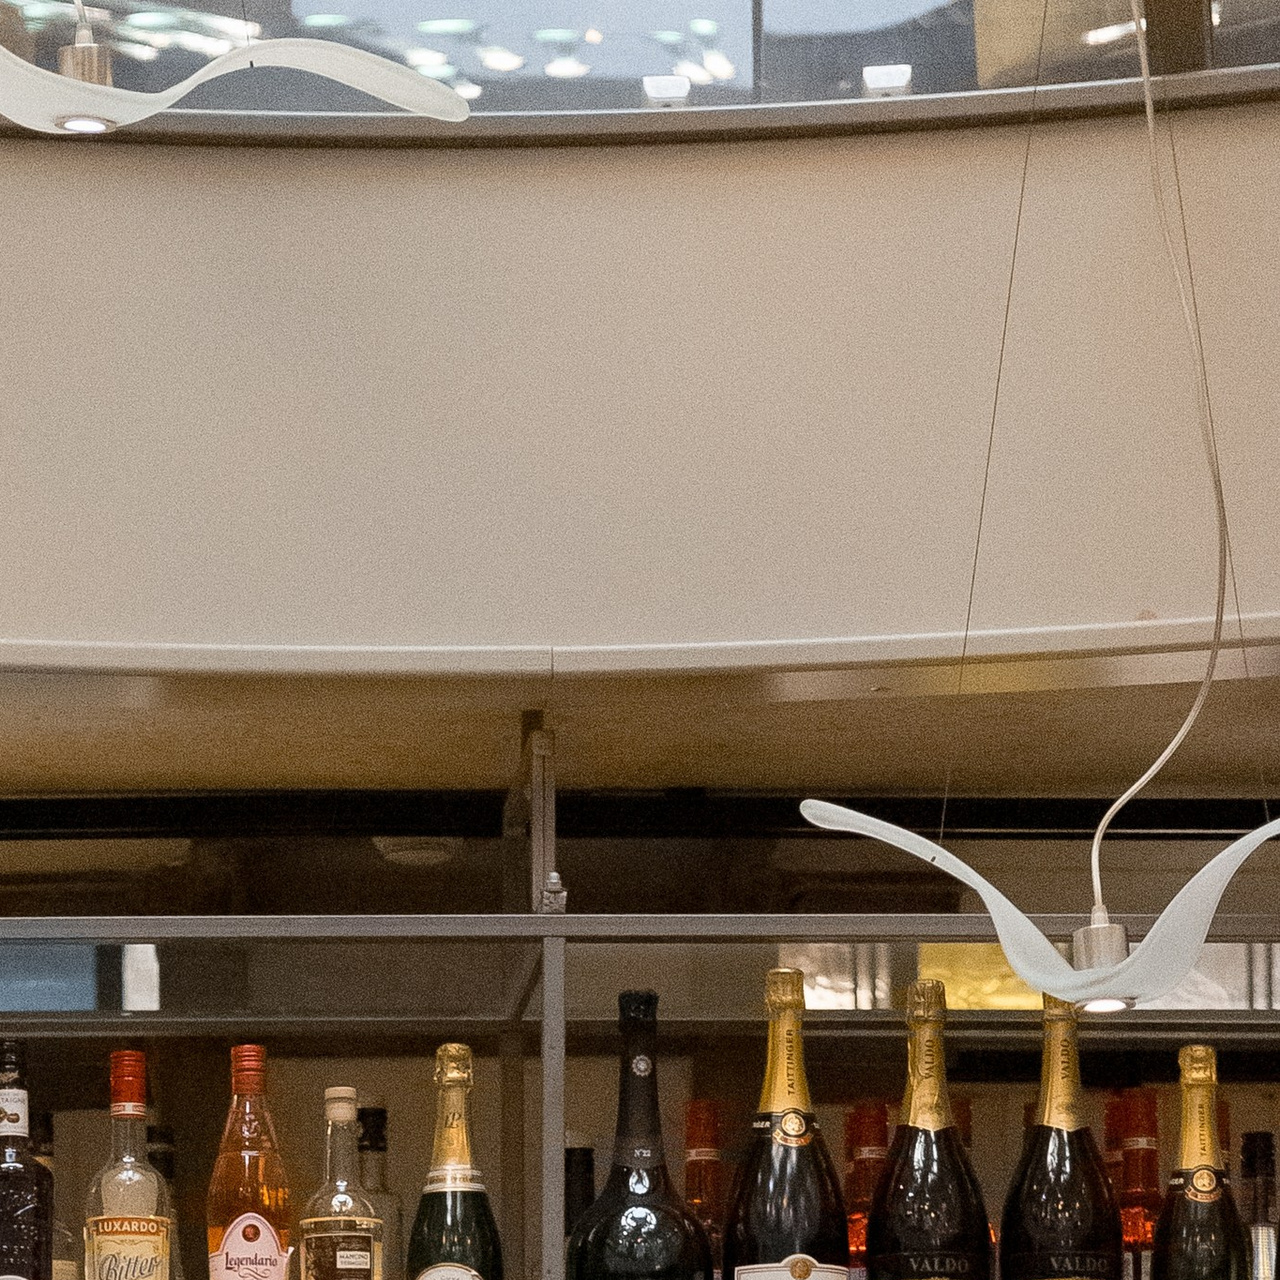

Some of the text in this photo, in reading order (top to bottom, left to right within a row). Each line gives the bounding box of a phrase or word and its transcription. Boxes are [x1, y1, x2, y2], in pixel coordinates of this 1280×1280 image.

[785, 1029, 796, 1096] TAITTINGER
[924, 1039, 935, 1079] VALDO
[1060, 1038, 1071, 1080] VALDO
[99, 1221, 158, 1233] LUXARDO
[225, 1251, 278, 1270] Legendario
[909, 1256, 969, 1273] VALDO
[1049, 1256, 1108, 1272] VALDO
